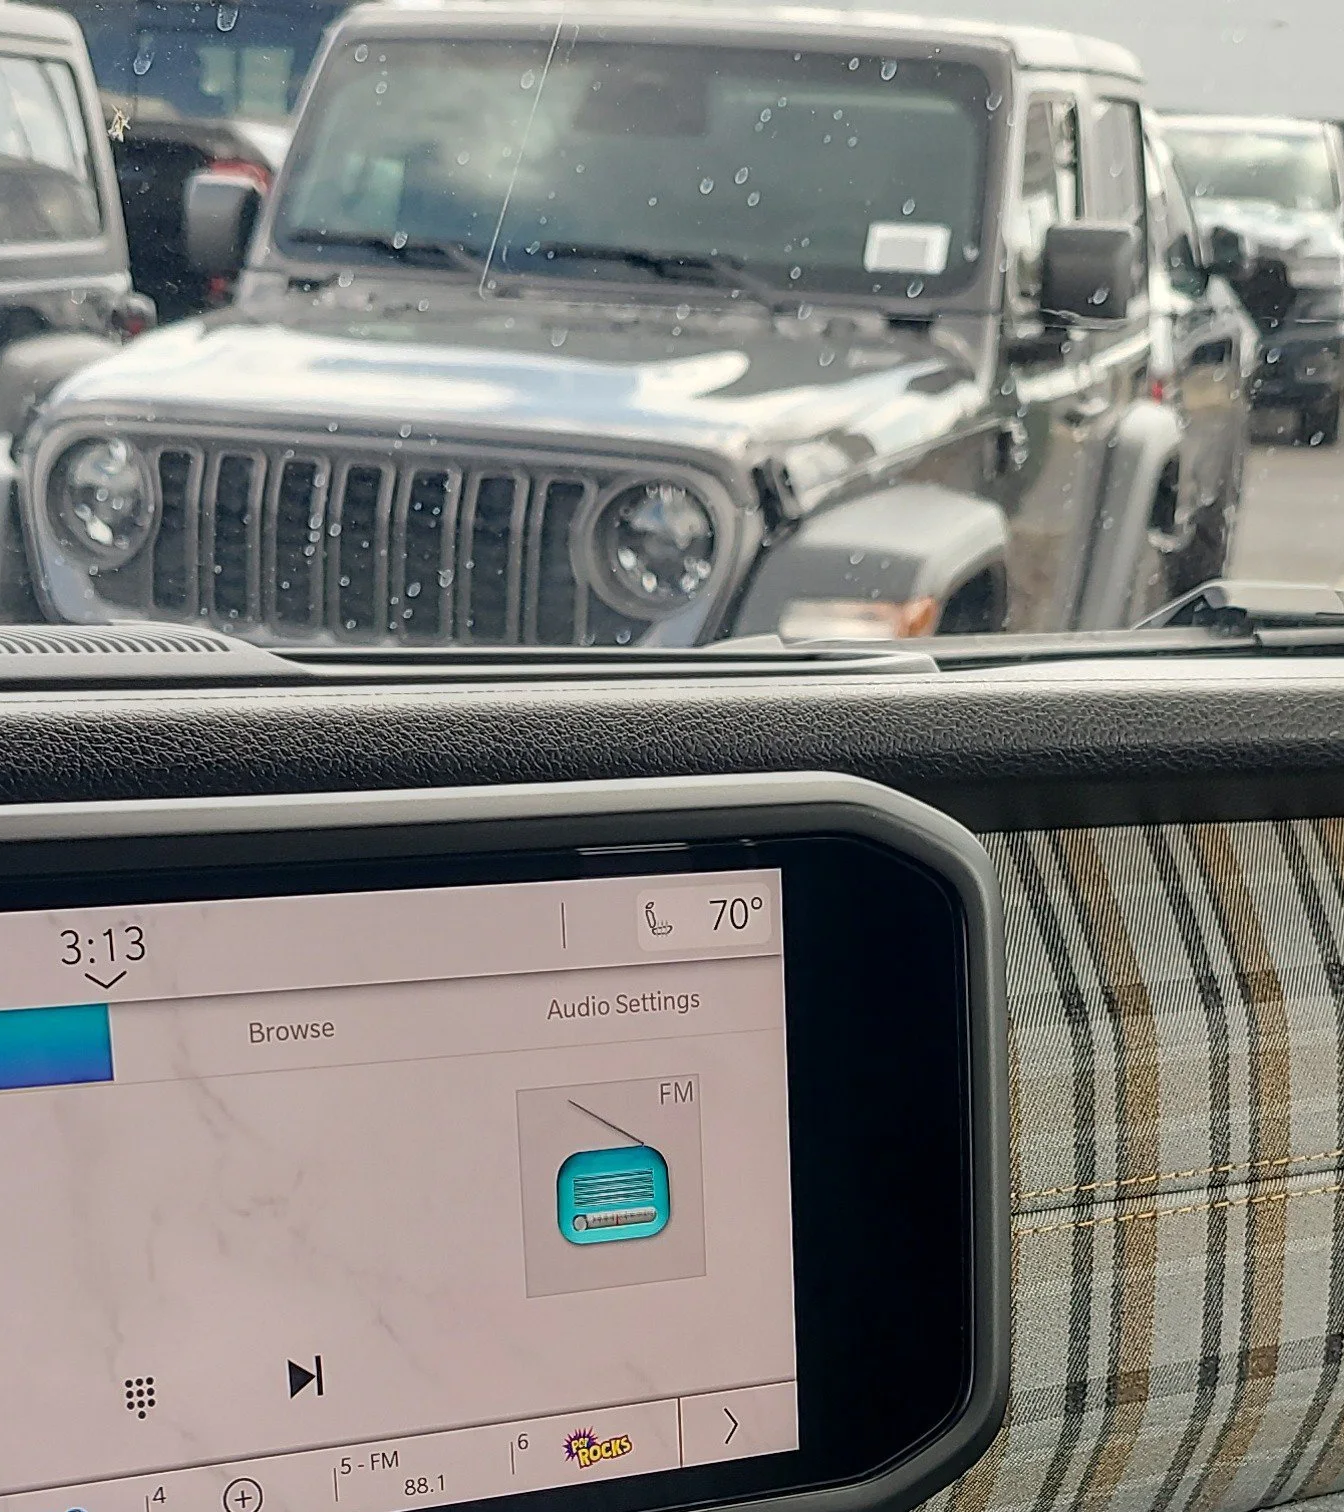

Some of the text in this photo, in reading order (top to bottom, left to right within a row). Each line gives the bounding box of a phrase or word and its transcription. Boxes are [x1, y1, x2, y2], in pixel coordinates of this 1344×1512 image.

[708, 897, 763, 932] 70°
[60, 926, 147, 966] 3:13
[547, 989, 701, 1020] Audio Settings
[248, 1018, 335, 1044] Browse
[659, 1082, 695, 1106] FM
[517, 1433, 529, 1451] 6
[577, 1435, 633, 1469] ROCKS
[340, 1457, 352, 1476] 5
[370, 1451, 400, 1472] FM
[152, 1487, 167, 1505] 4
[404, 1475, 447, 1497] 88.1
